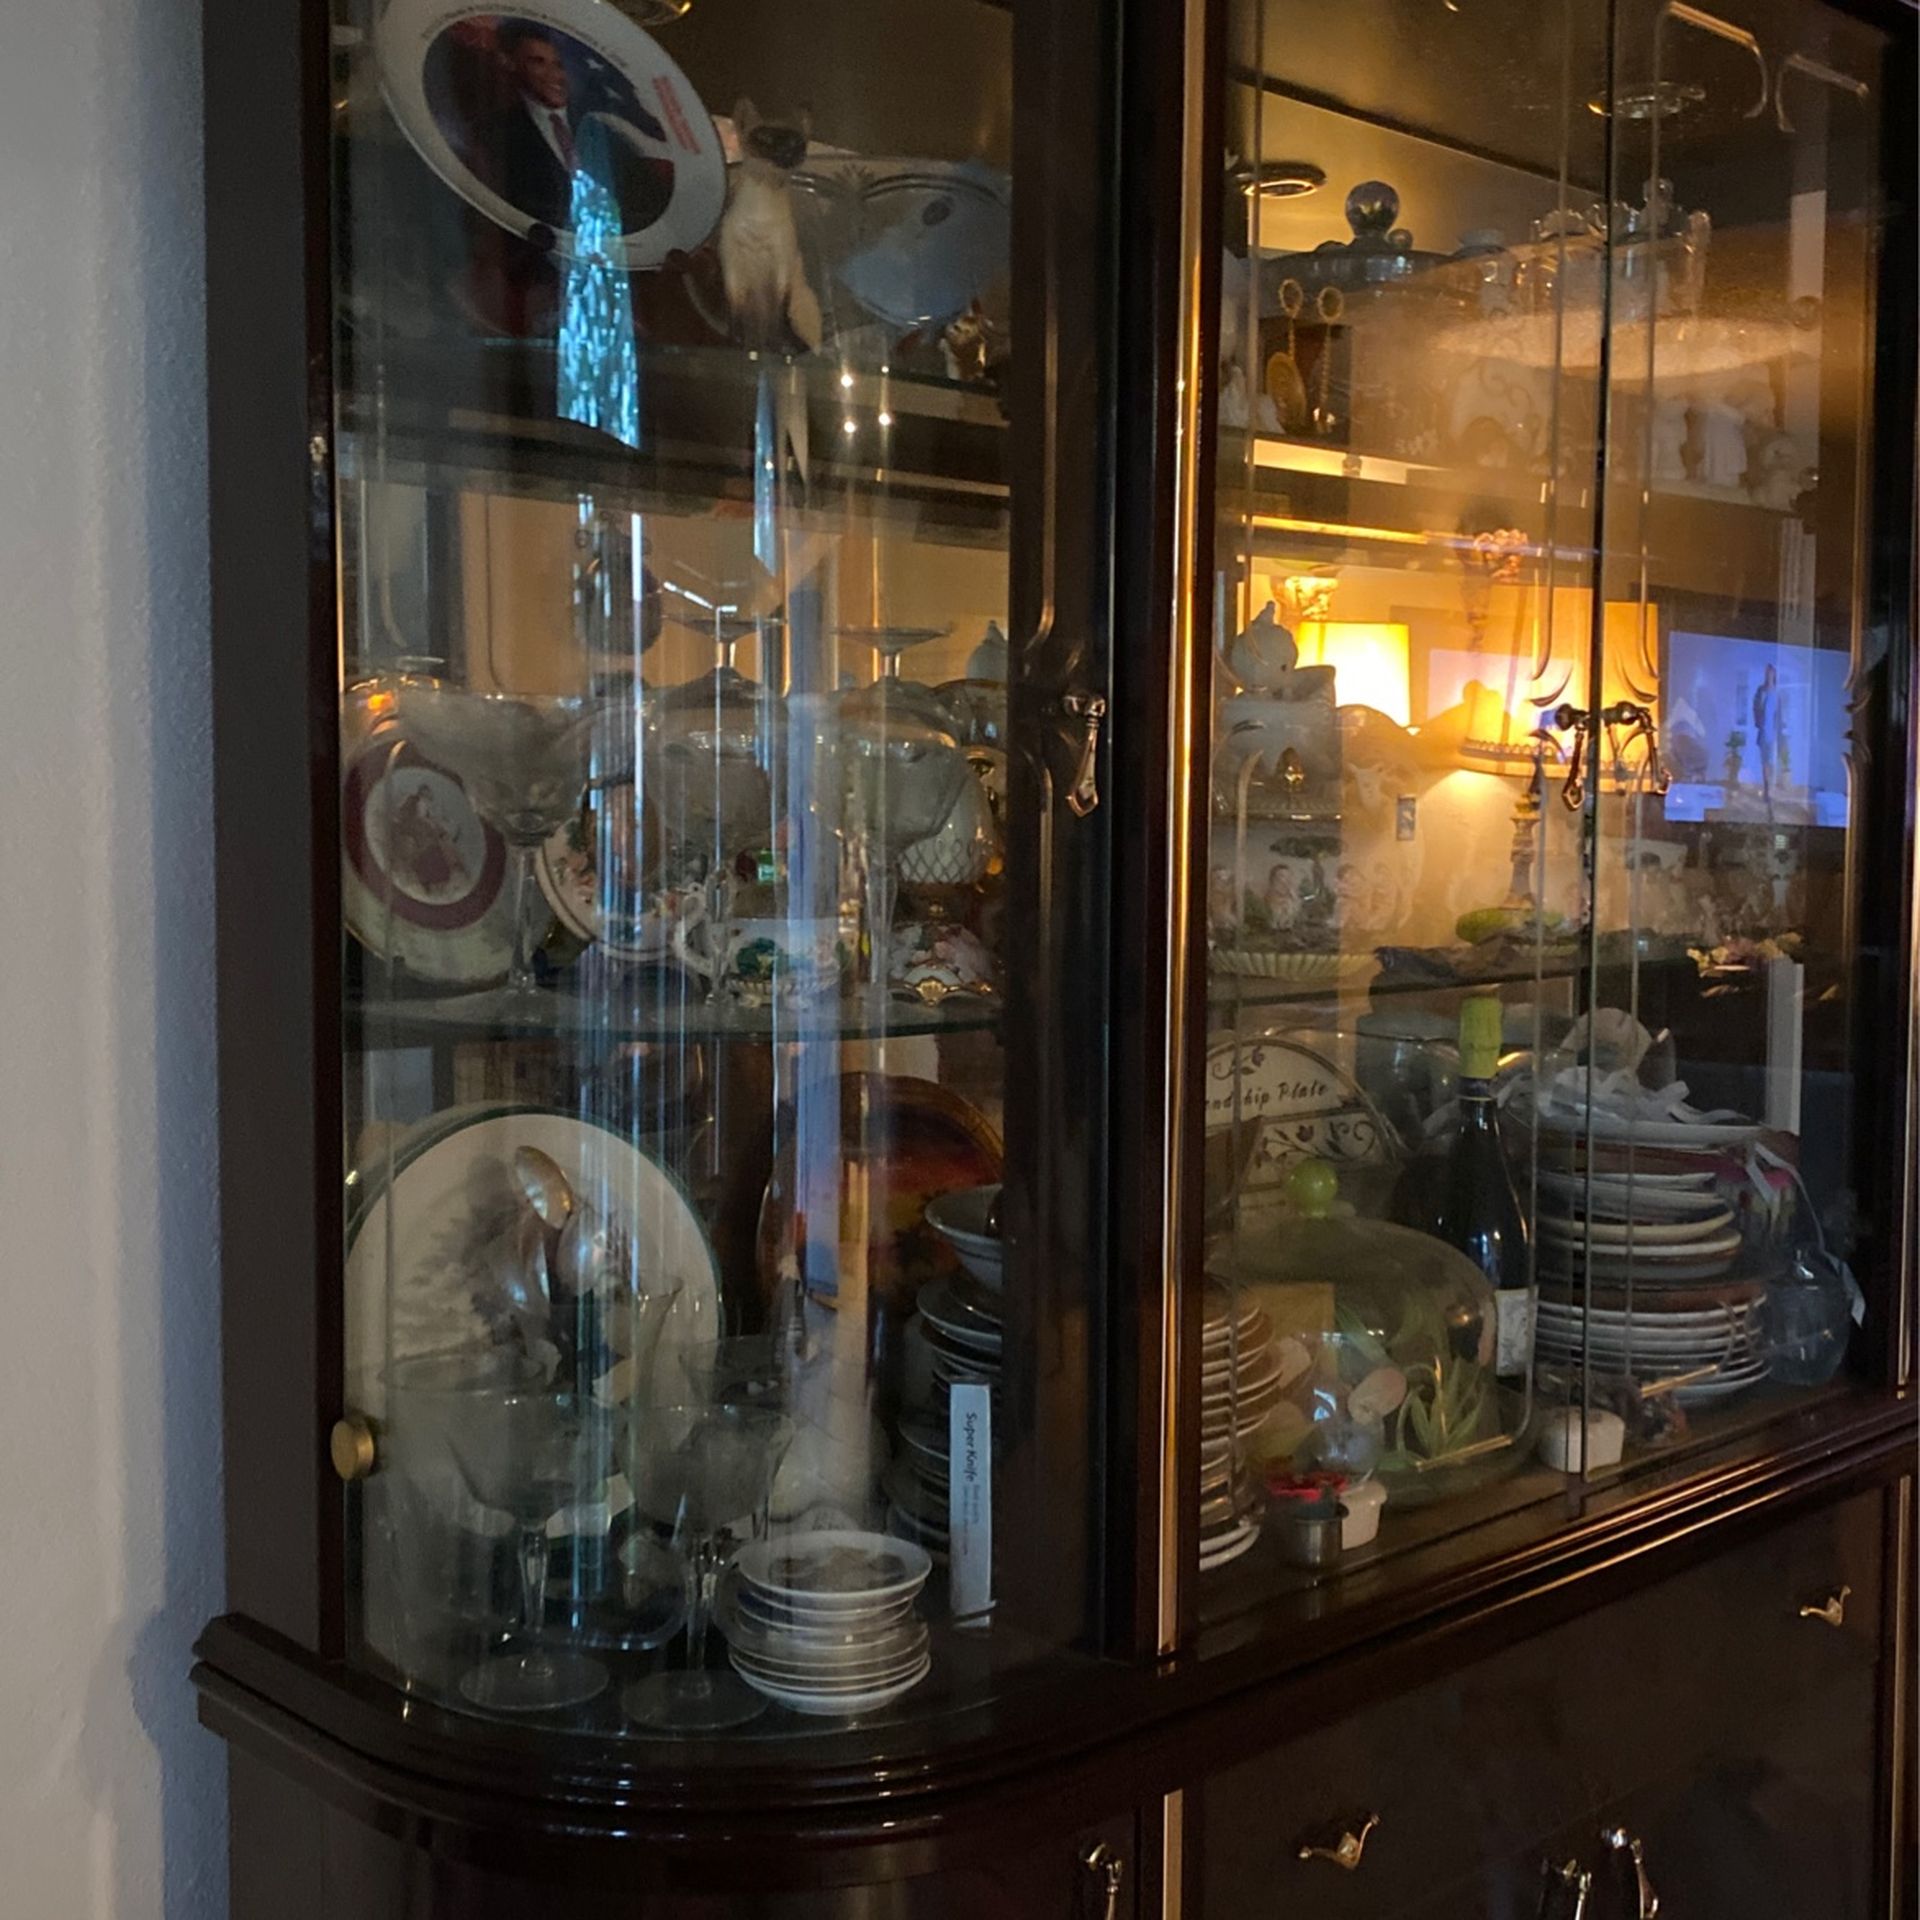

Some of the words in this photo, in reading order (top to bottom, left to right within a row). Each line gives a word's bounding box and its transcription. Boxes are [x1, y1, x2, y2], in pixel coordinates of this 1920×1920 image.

[1277, 1079, 1328, 1101] Plate
[964, 1412, 978, 1448] Super
[964, 1450, 979, 1483] Knife
